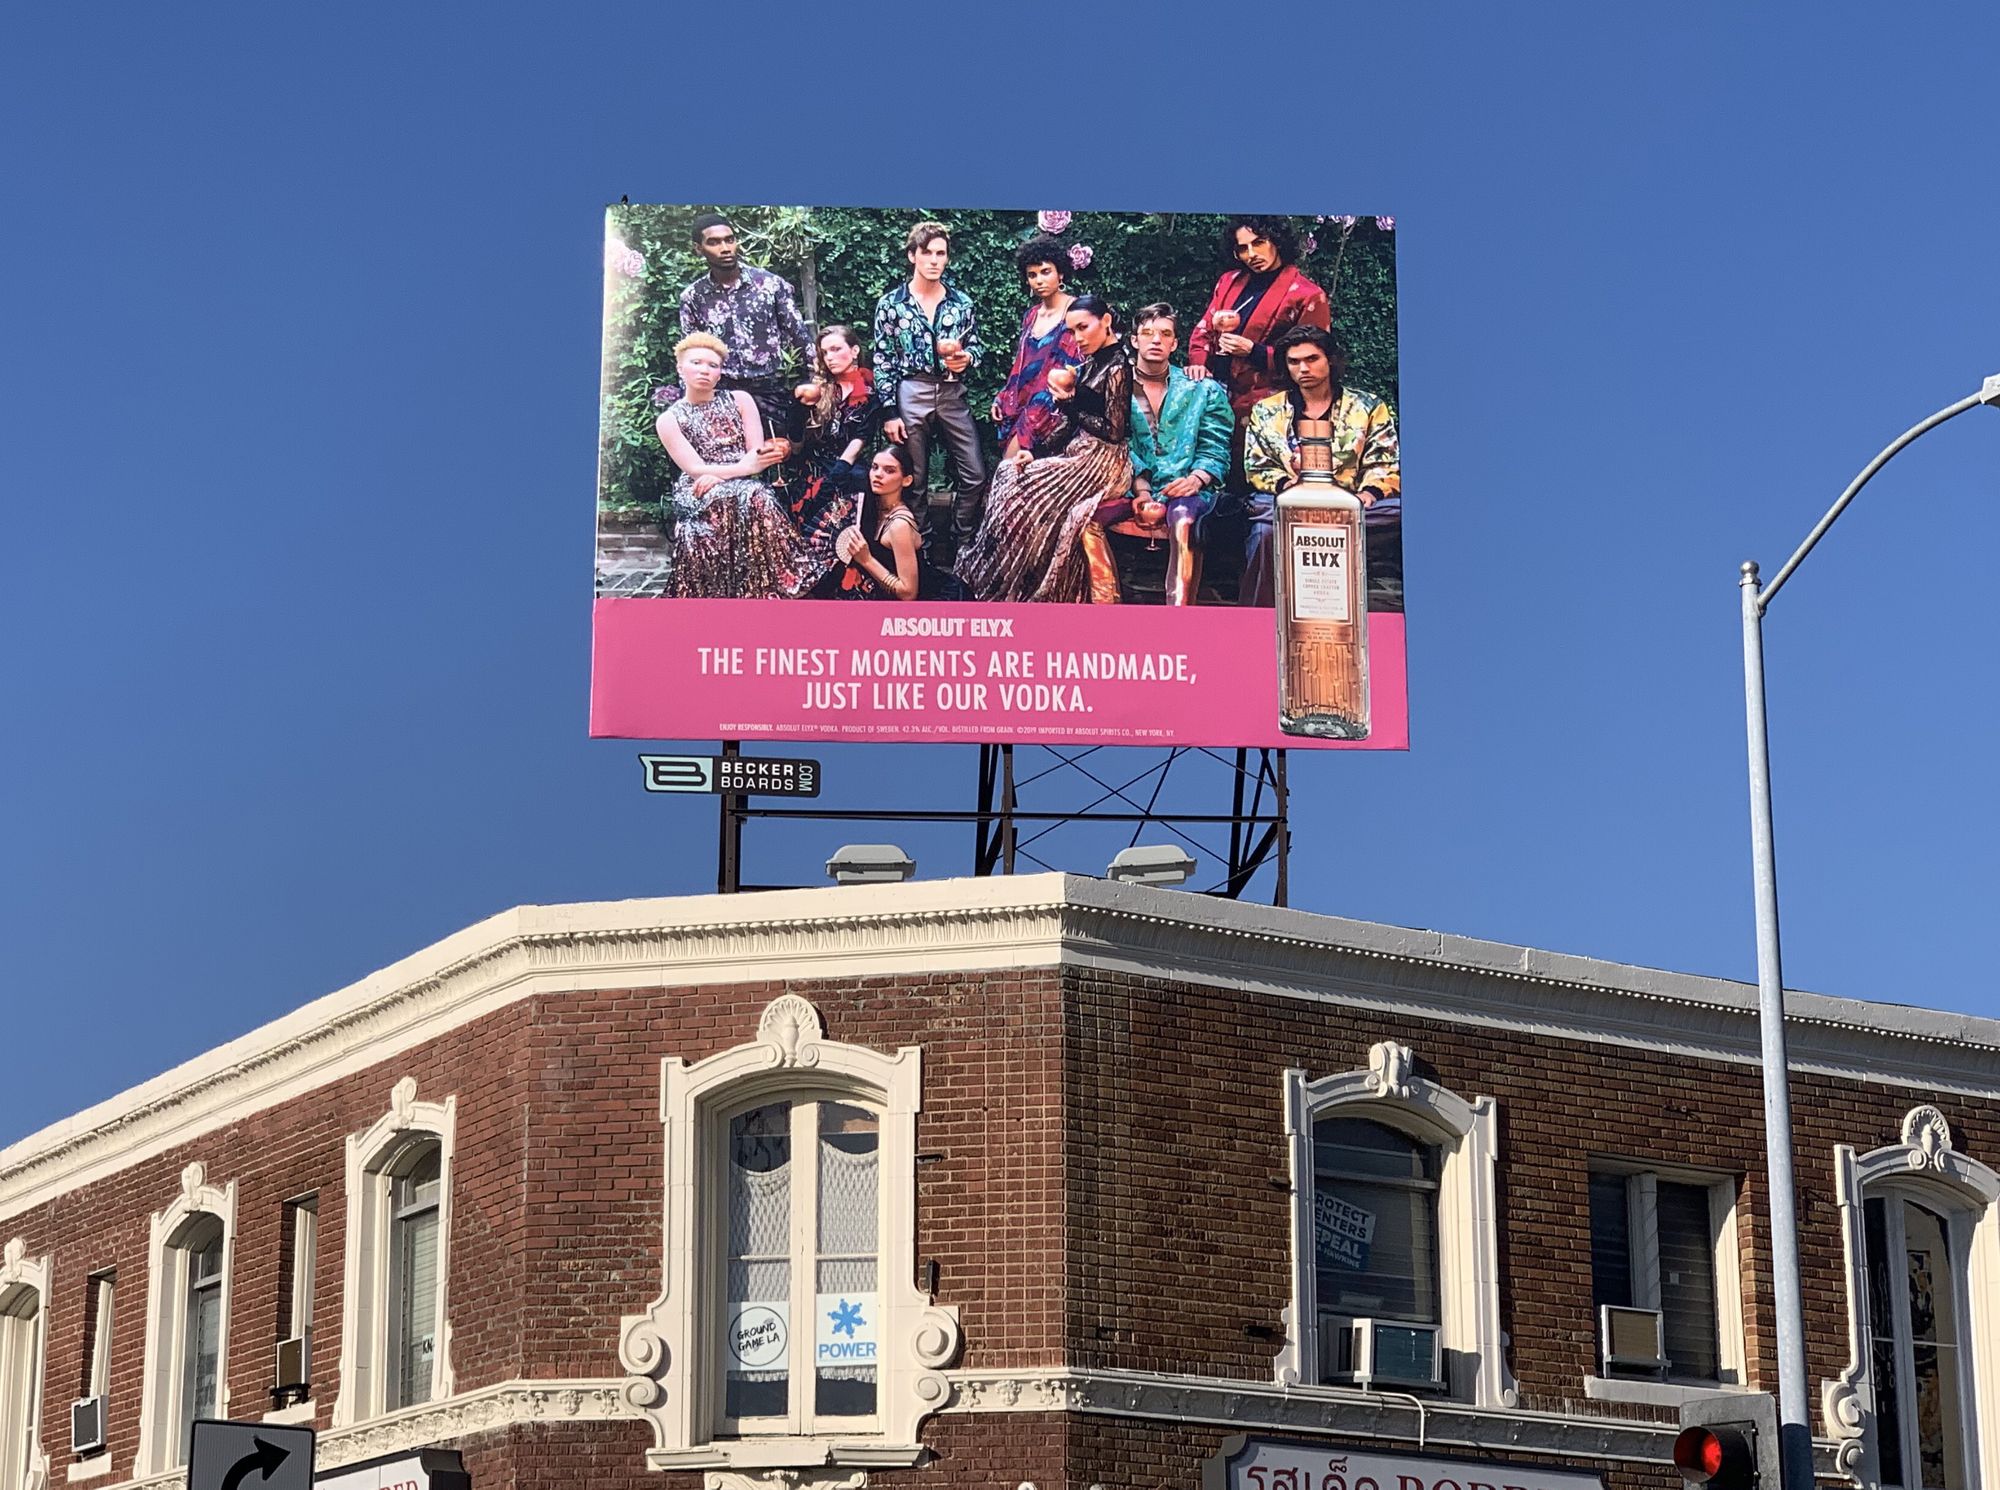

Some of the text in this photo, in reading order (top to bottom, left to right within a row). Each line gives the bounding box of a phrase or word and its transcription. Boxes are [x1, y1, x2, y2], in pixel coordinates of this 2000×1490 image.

[1296, 536, 1345, 548] ABSOLUT
[1303, 552, 1340, 567] ELYX
[881, 617, 1014, 638] ABSOLUT ELYX
[698, 648, 1197, 685] THE FINEST MOMENTS ARE HANDMADE,
[802, 682, 1094, 713] JUST LIKE OUR VODKA.
[719, 723, 737, 732] ENJOY
[776, 724, 800, 732] ABSOLUT
[842, 725, 866, 733] PRODUCT
[952, 726, 979, 734] DISTILLED
[980, 726, 996, 734] FROM
[1038, 727, 1066, 735] IMPORTED
[1075, 728, 1099, 736] ABSOLUT
[1100, 728, 1121, 737] SPIRITS
[1135, 729, 1148, 737] NEW
[721, 761, 794, 776] BECKER
[721, 777, 794, 791] BOARDS
[1315, 1193, 1369, 1225] ROTECT
[1315, 1207, 1367, 1239] ENTERS
[737, 1322, 777, 1341] GROUND
[738, 1332, 780, 1352] GAME LA
[819, 1342, 877, 1358] POWER
